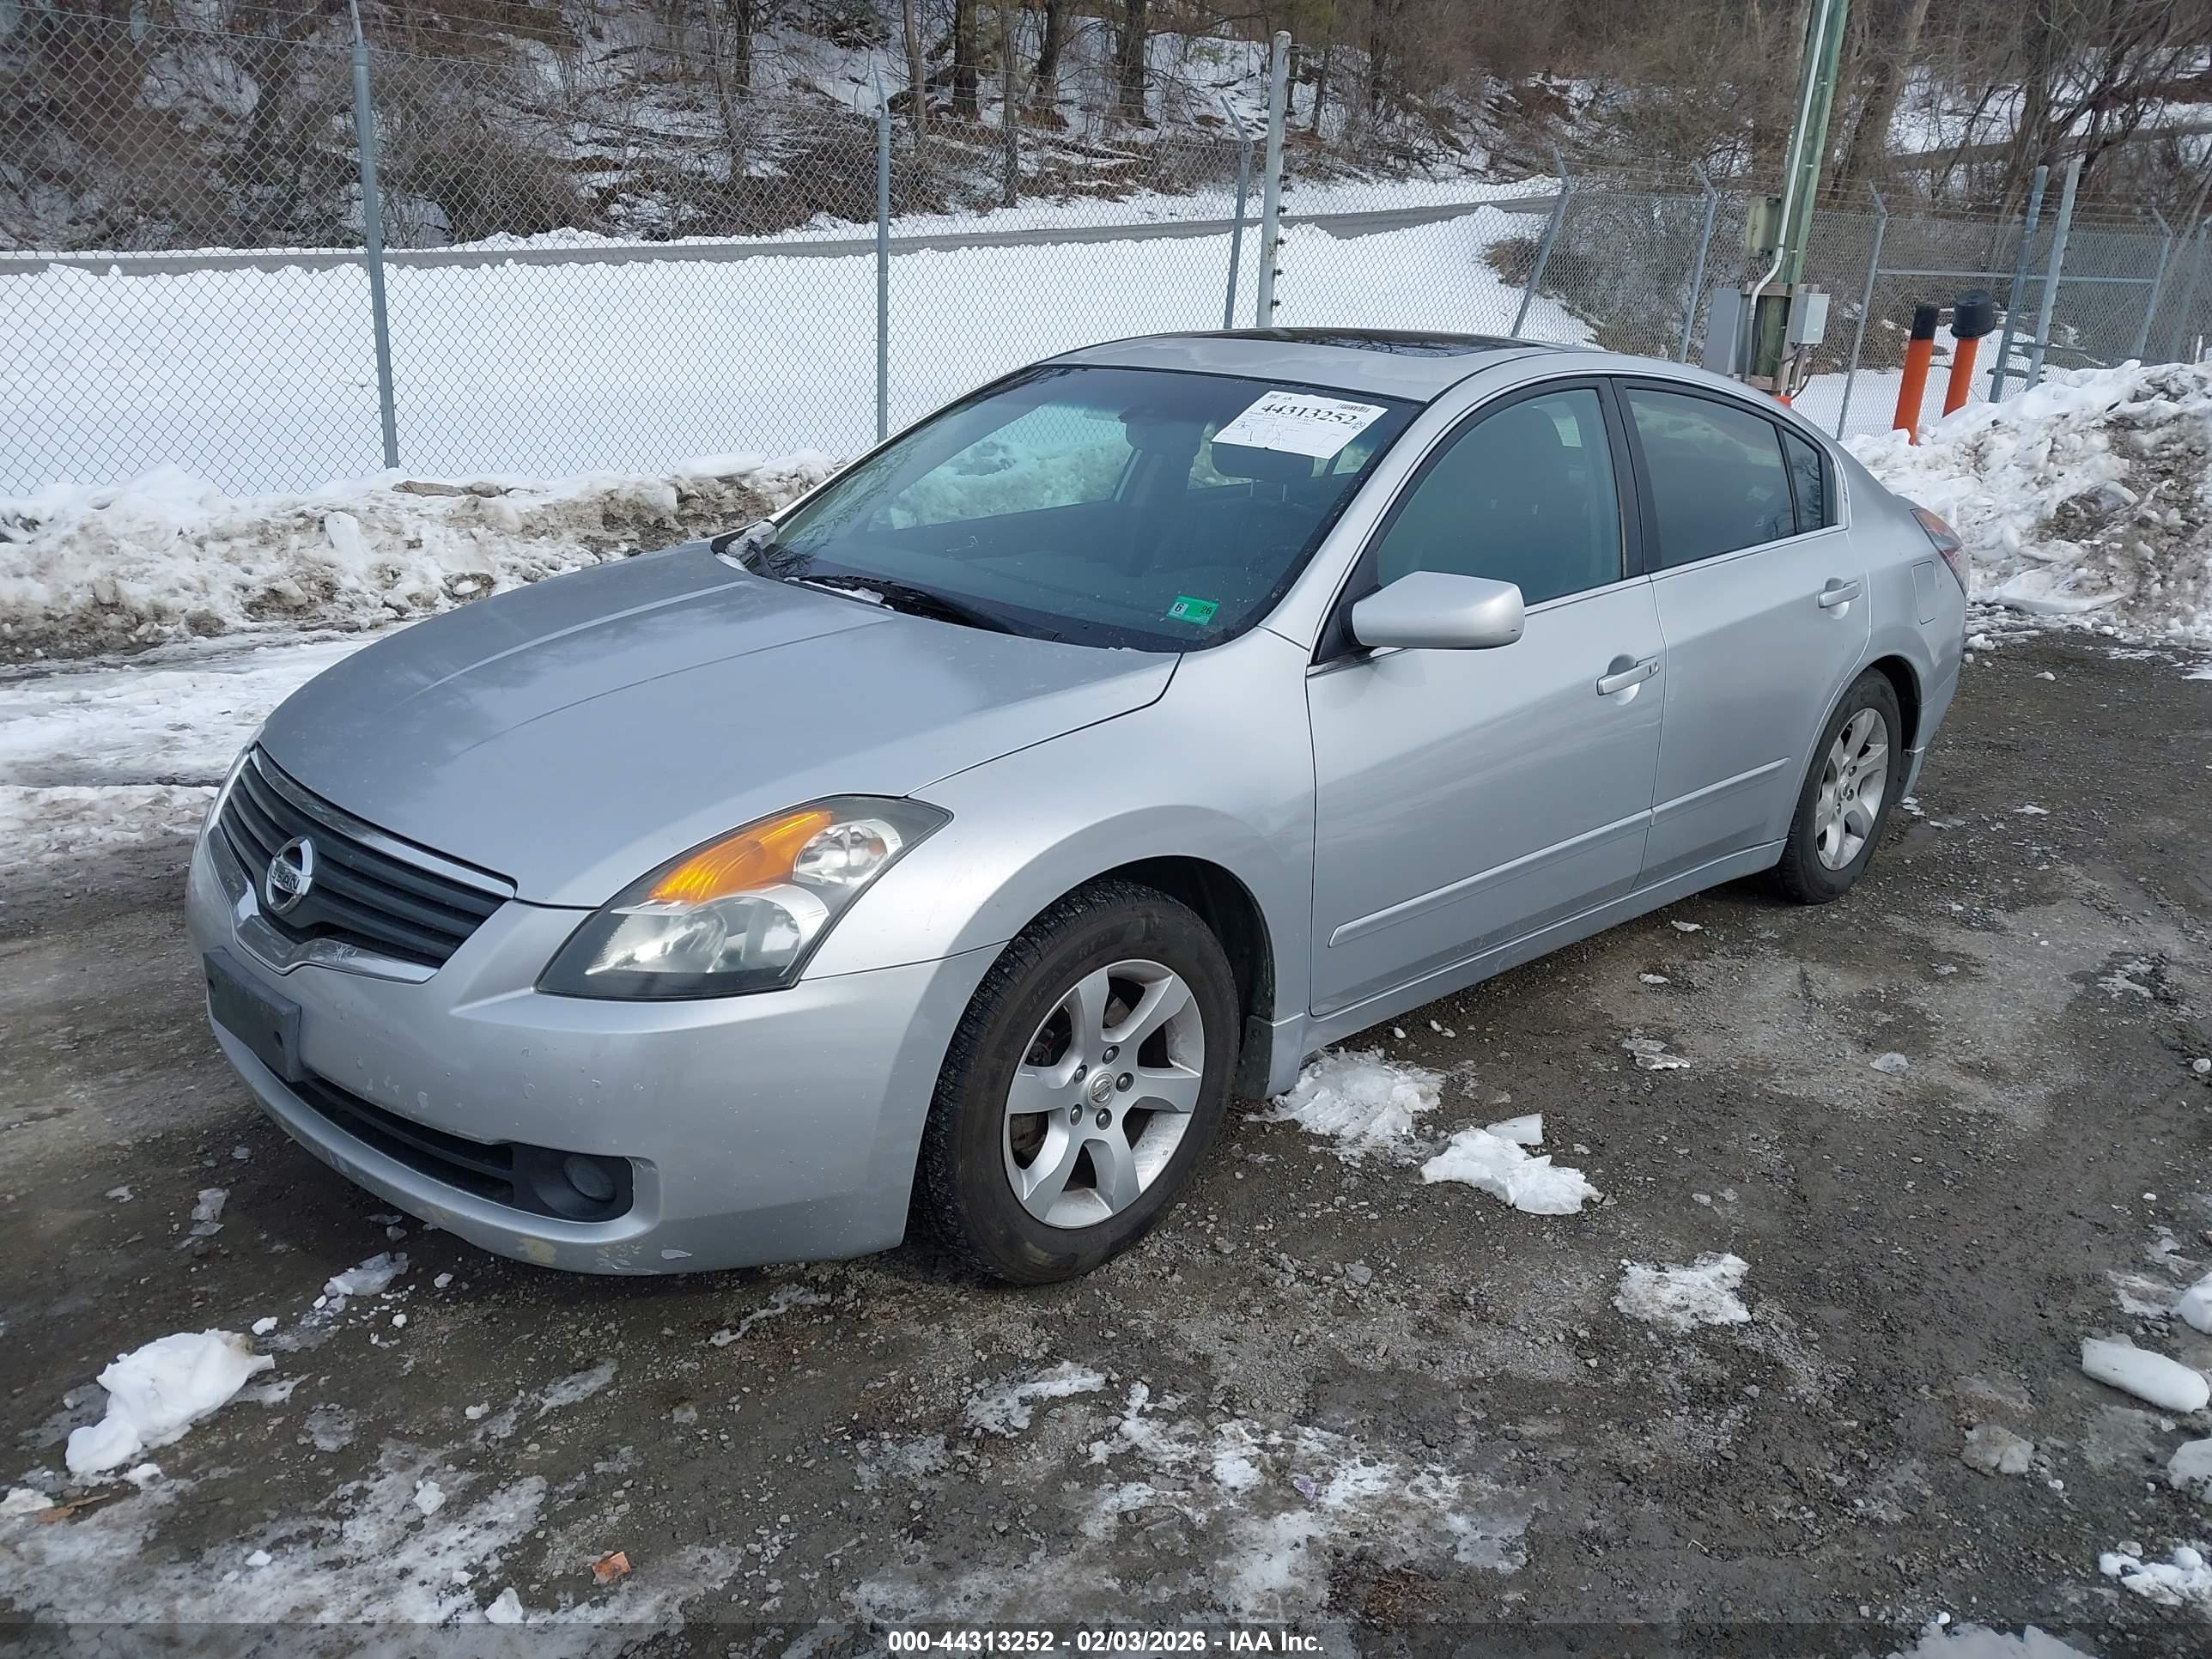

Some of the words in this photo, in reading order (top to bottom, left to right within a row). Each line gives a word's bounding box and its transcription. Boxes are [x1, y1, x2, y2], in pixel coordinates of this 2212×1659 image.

[1261, 403, 1358, 425] 44313252
[1174, 603, 1184, 612] 6
[1200, 605, 1213, 615] 26
